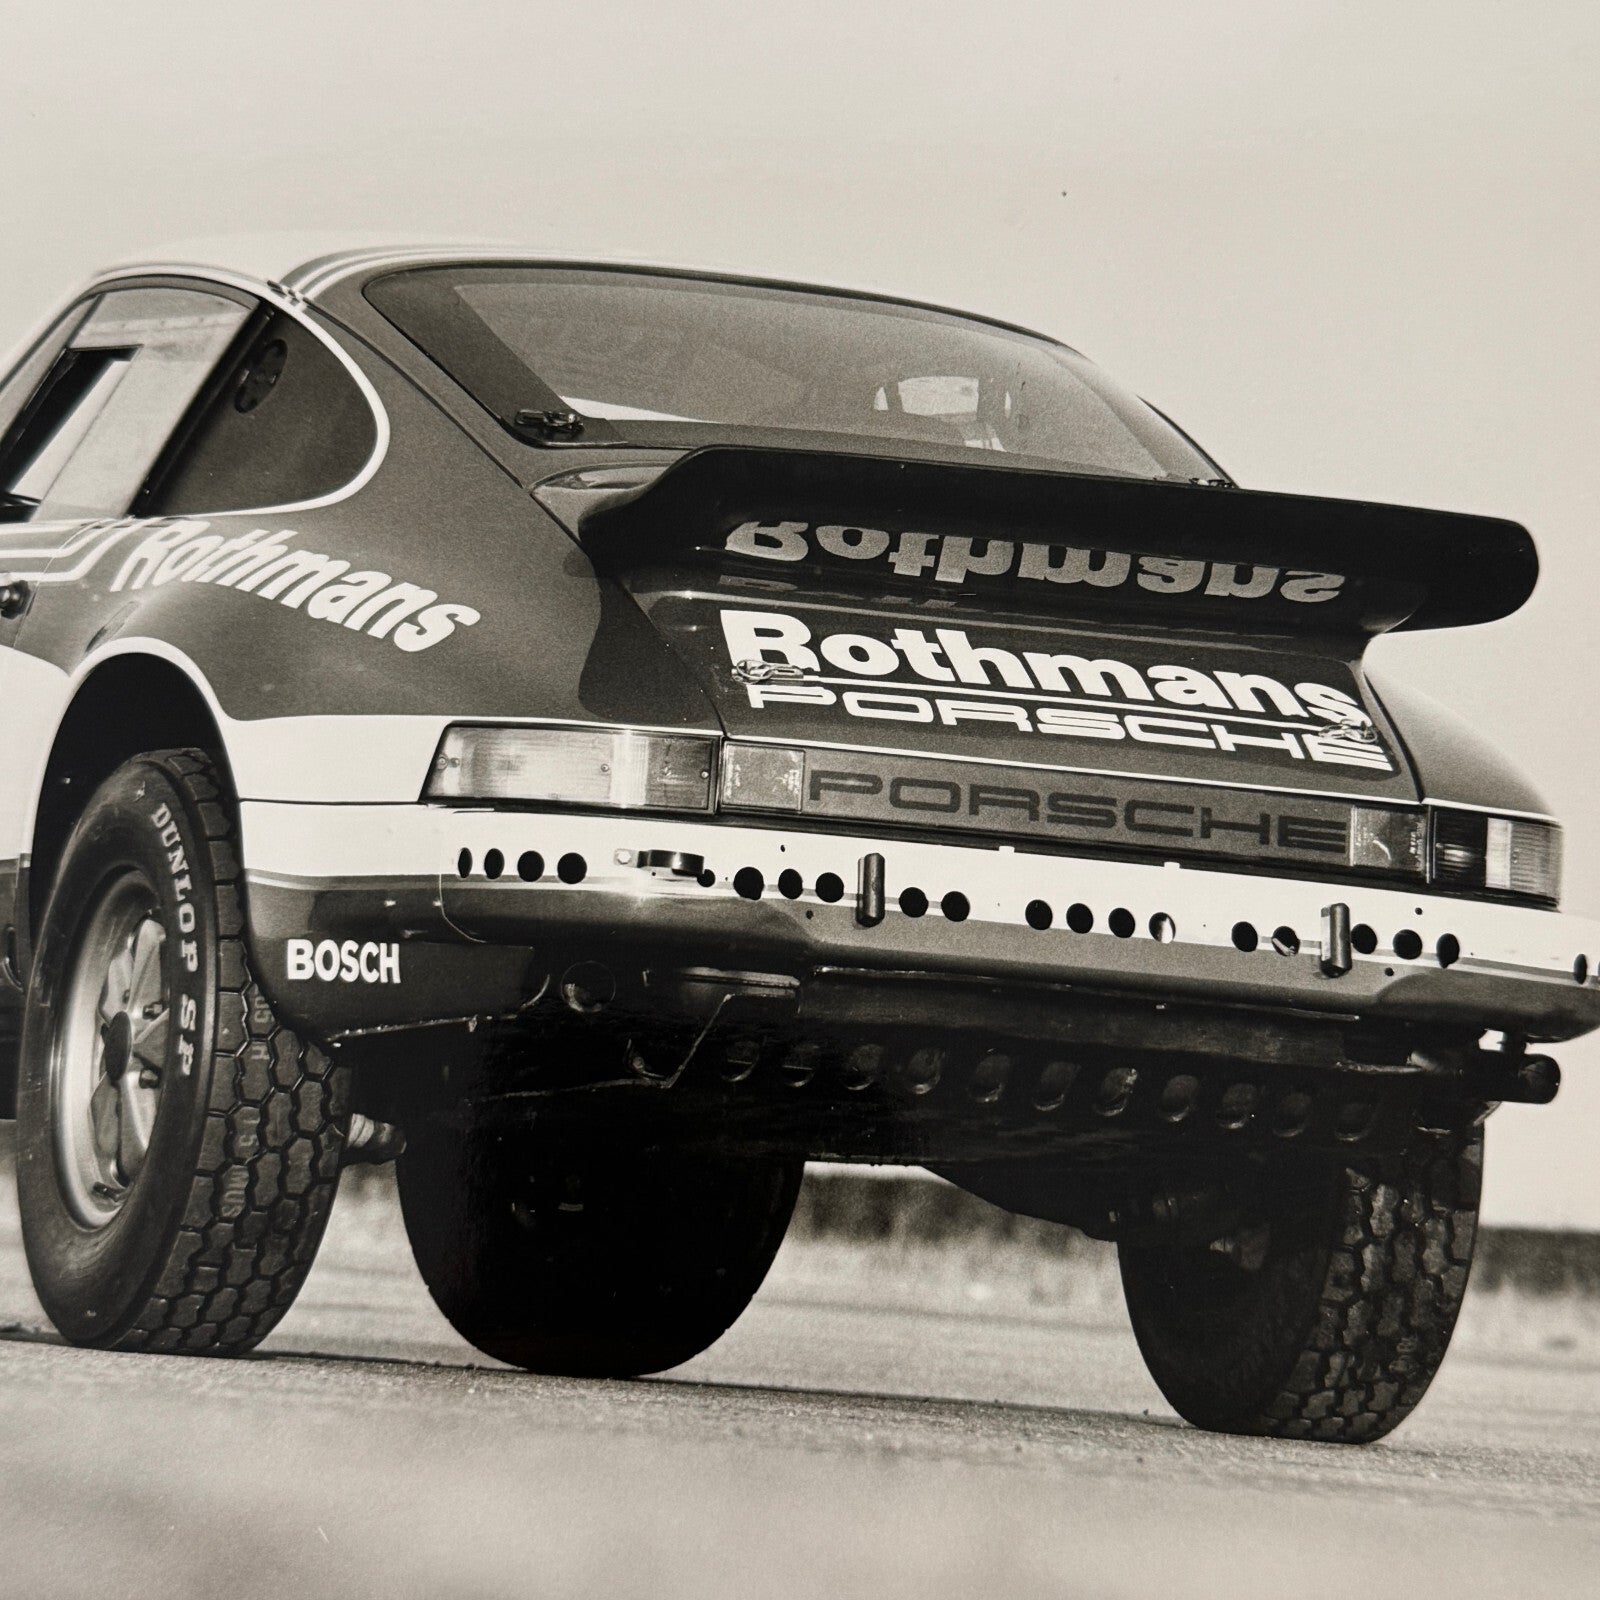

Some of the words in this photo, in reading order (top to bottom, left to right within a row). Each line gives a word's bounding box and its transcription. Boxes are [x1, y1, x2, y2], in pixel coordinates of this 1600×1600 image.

[110, 520, 481, 652] Rothmans
[720, 609, 1373, 728] Rothmans
[746, 684, 1394, 771] PORSCHE
[809, 769, 1347, 854] PORSCHE
[151, 802, 198, 973] DUNLOP
[178, 993, 196, 1076] SP
[287, 938, 401, 984] BOSCH
